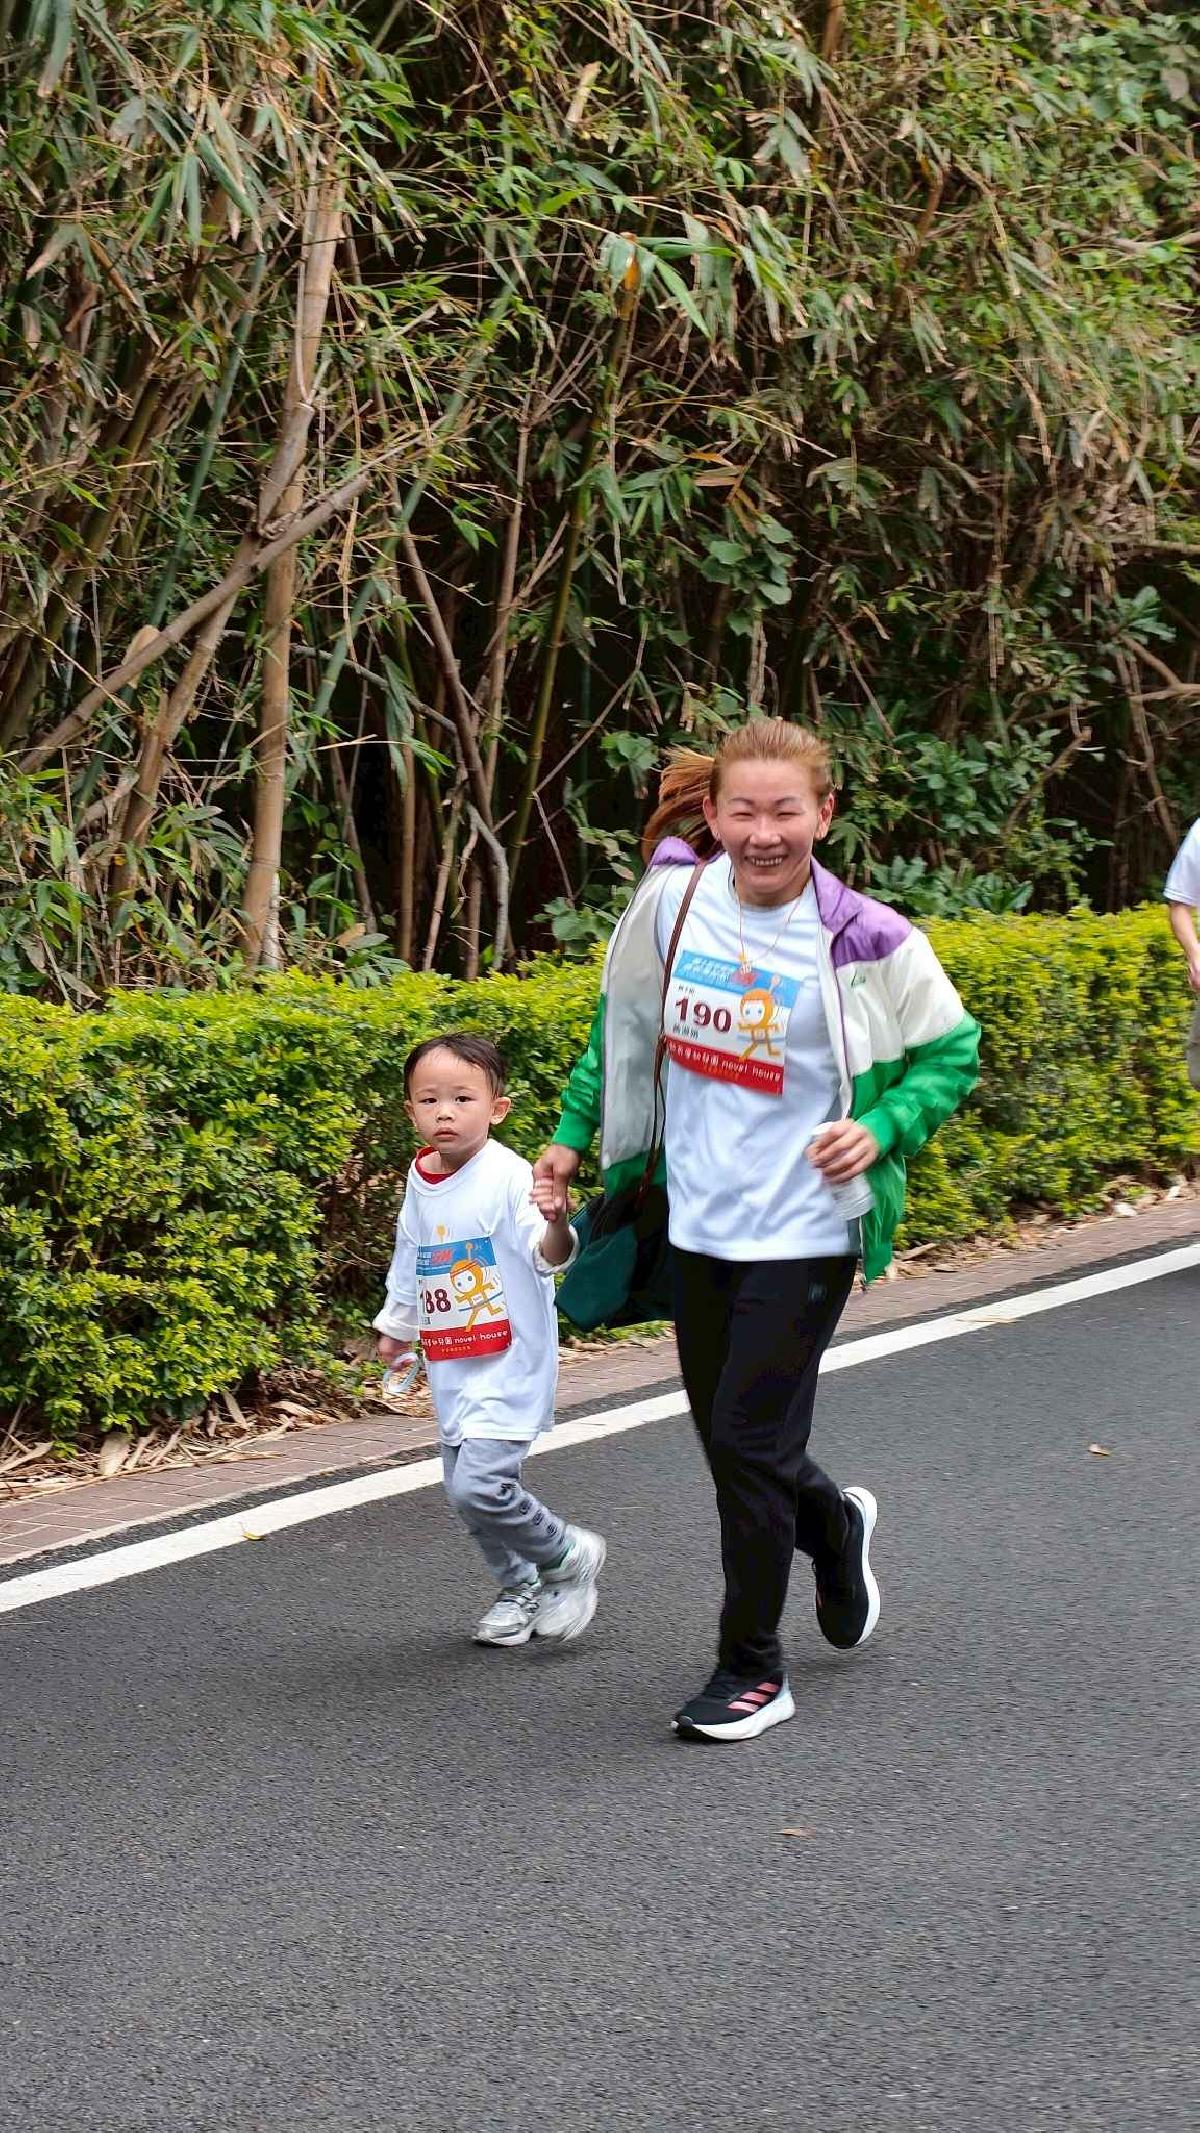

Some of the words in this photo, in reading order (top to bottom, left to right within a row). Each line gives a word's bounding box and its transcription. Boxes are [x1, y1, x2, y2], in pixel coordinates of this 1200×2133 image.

[675, 997, 732, 1034] 190
[454, 1335, 477, 1344] novel
[480, 1331, 508, 1341] house
